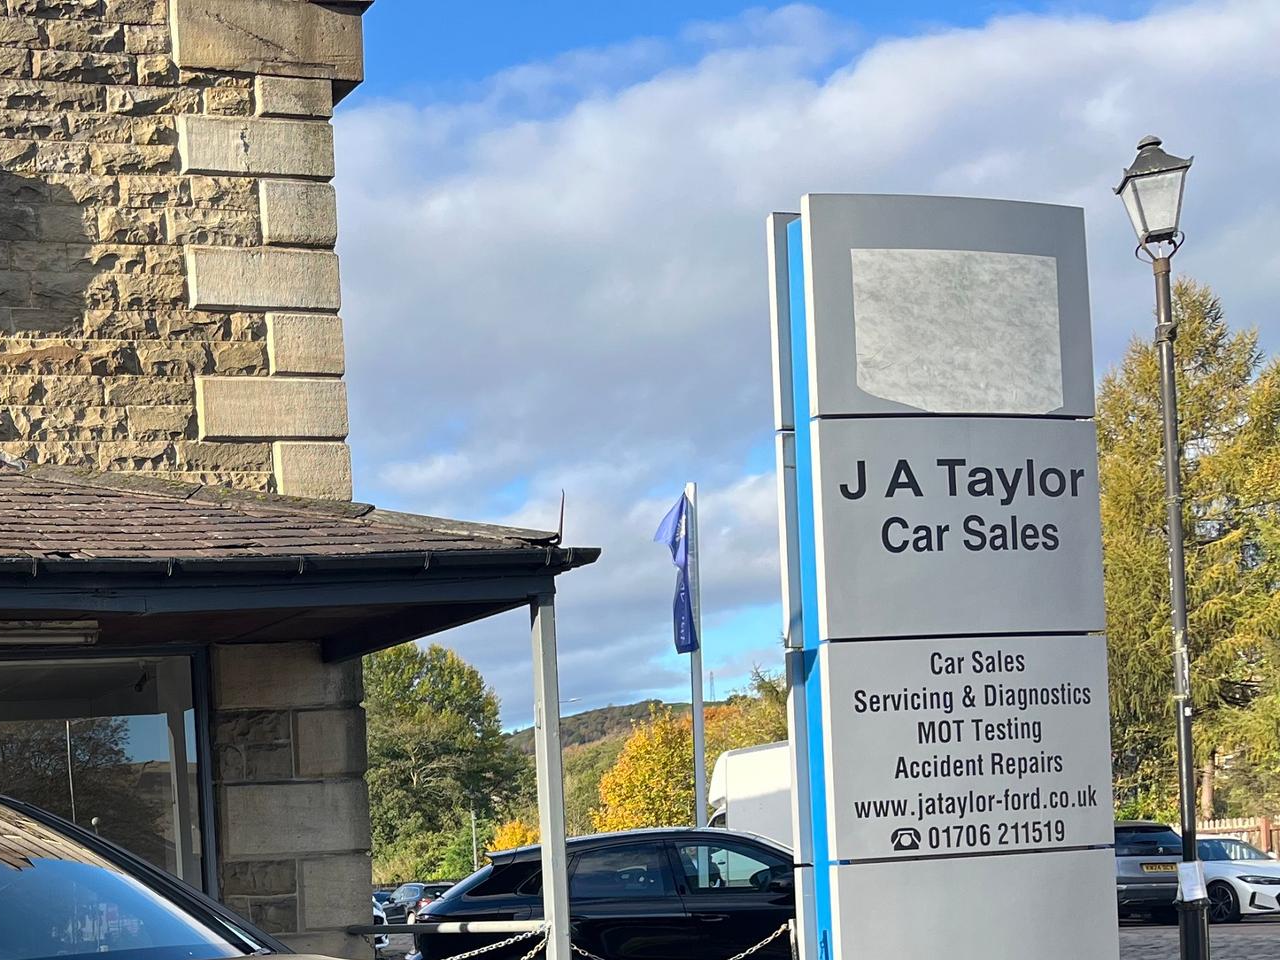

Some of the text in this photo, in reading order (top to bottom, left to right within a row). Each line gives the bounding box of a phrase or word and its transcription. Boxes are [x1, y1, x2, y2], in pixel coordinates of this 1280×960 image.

[839, 458, 1086, 506] J A Taylor
[881, 514, 1060, 554] Car Sales
[930, 649, 1026, 676] Car Sales
[854, 682, 1092, 714] Servicing & Diagnostics
[917, 716, 1043, 745] MOT Testing
[894, 750, 1064, 780] Accident Repairs
[854, 784, 1099, 821] www.jataylor-ford.co.uk
[928, 819, 1066, 849] 01706 211519
